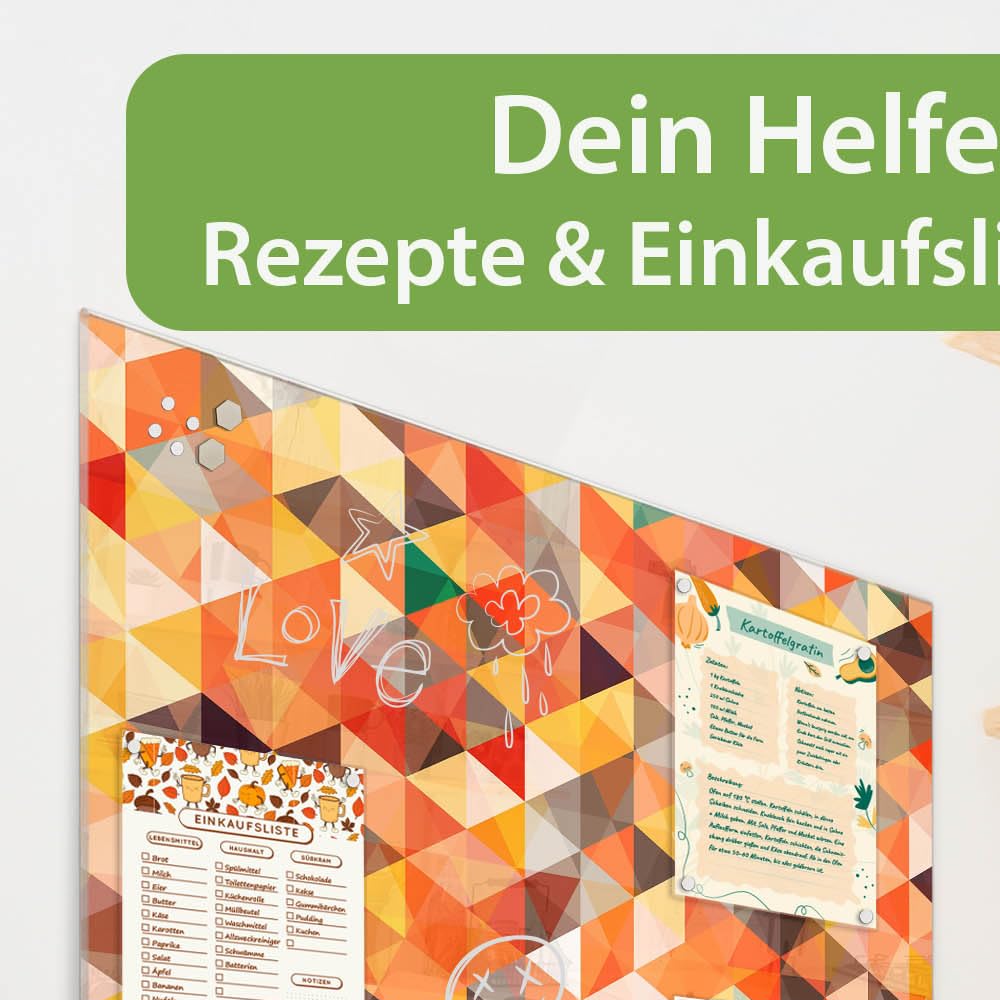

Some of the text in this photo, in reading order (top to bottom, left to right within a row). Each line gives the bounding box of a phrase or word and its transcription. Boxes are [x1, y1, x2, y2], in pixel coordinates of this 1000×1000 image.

[740, 618, 823, 658] Kartoffelgratin
[195, 814, 299, 838] EINKAUFSLISTE
[148, 834, 199, 846] LEBENSMITTEL
[229, 845, 264, 854] HAUSHALT
[152, 855, 168, 863] Brot
[152, 870, 171, 878] Milch
[224, 864, 261, 876] Spülmittel
[295, 873, 332, 883] Schokolade
[224, 879, 276, 892] Toilettenpapier
[295, 888, 314, 896] Kekse
[152, 897, 176, 906] Butter
[225, 893, 264, 904] Küchenrolle
[225, 906, 260, 915] Müllbeutel
[295, 901, 345, 912] Gummibärchen
[295, 914, 323, 924] Pudding
[152, 926, 184, 934] Karotten
[225, 920, 267, 930] Waschmittel
[296, 928, 320, 936] Kuchen
[224, 933, 280, 945] Allzweckreiniger
[151, 940, 180, 951] Paprika
[152, 954, 171, 962] Salat
[224, 948, 264, 958] Schwämme
[225, 961, 258, 970] Batterien
[152, 982, 184, 991] Bananen
